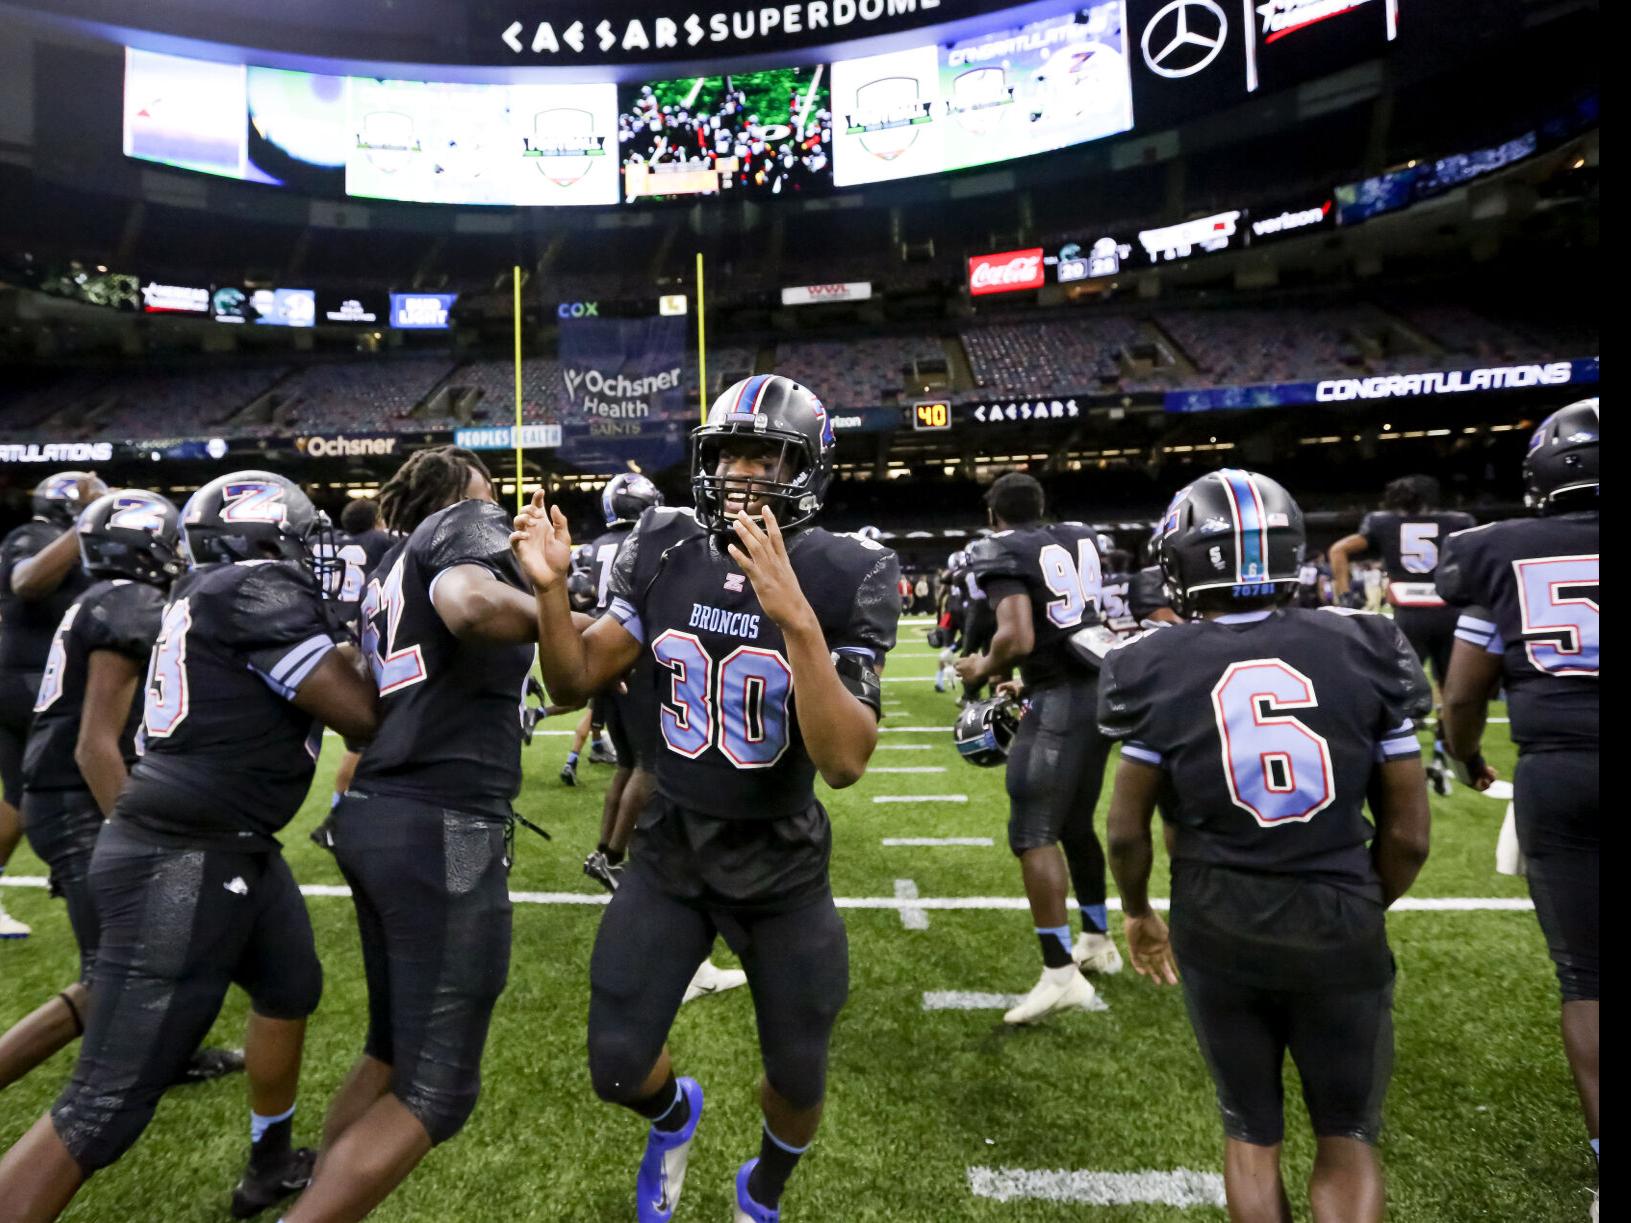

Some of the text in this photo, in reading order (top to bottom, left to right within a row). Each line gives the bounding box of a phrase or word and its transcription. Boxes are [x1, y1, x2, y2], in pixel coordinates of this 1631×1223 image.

[558, 302, 598, 318] COX
[585, 368, 681, 397] Ochsner
[1316, 362, 1571, 402] CONGRATULATIONS
[583, 396, 648, 418] Health
[917, 404, 947, 427] 40
[974, 400, 1079, 423] CAESARS
[307, 436, 396, 457] Ochsner
[1401, 522, 1439, 573] 5
[1039, 537, 1103, 629] 94
[689, 603, 761, 639] BRONCOS
[651, 628, 794, 769] 30
[1211, 657, 1336, 828] 6
